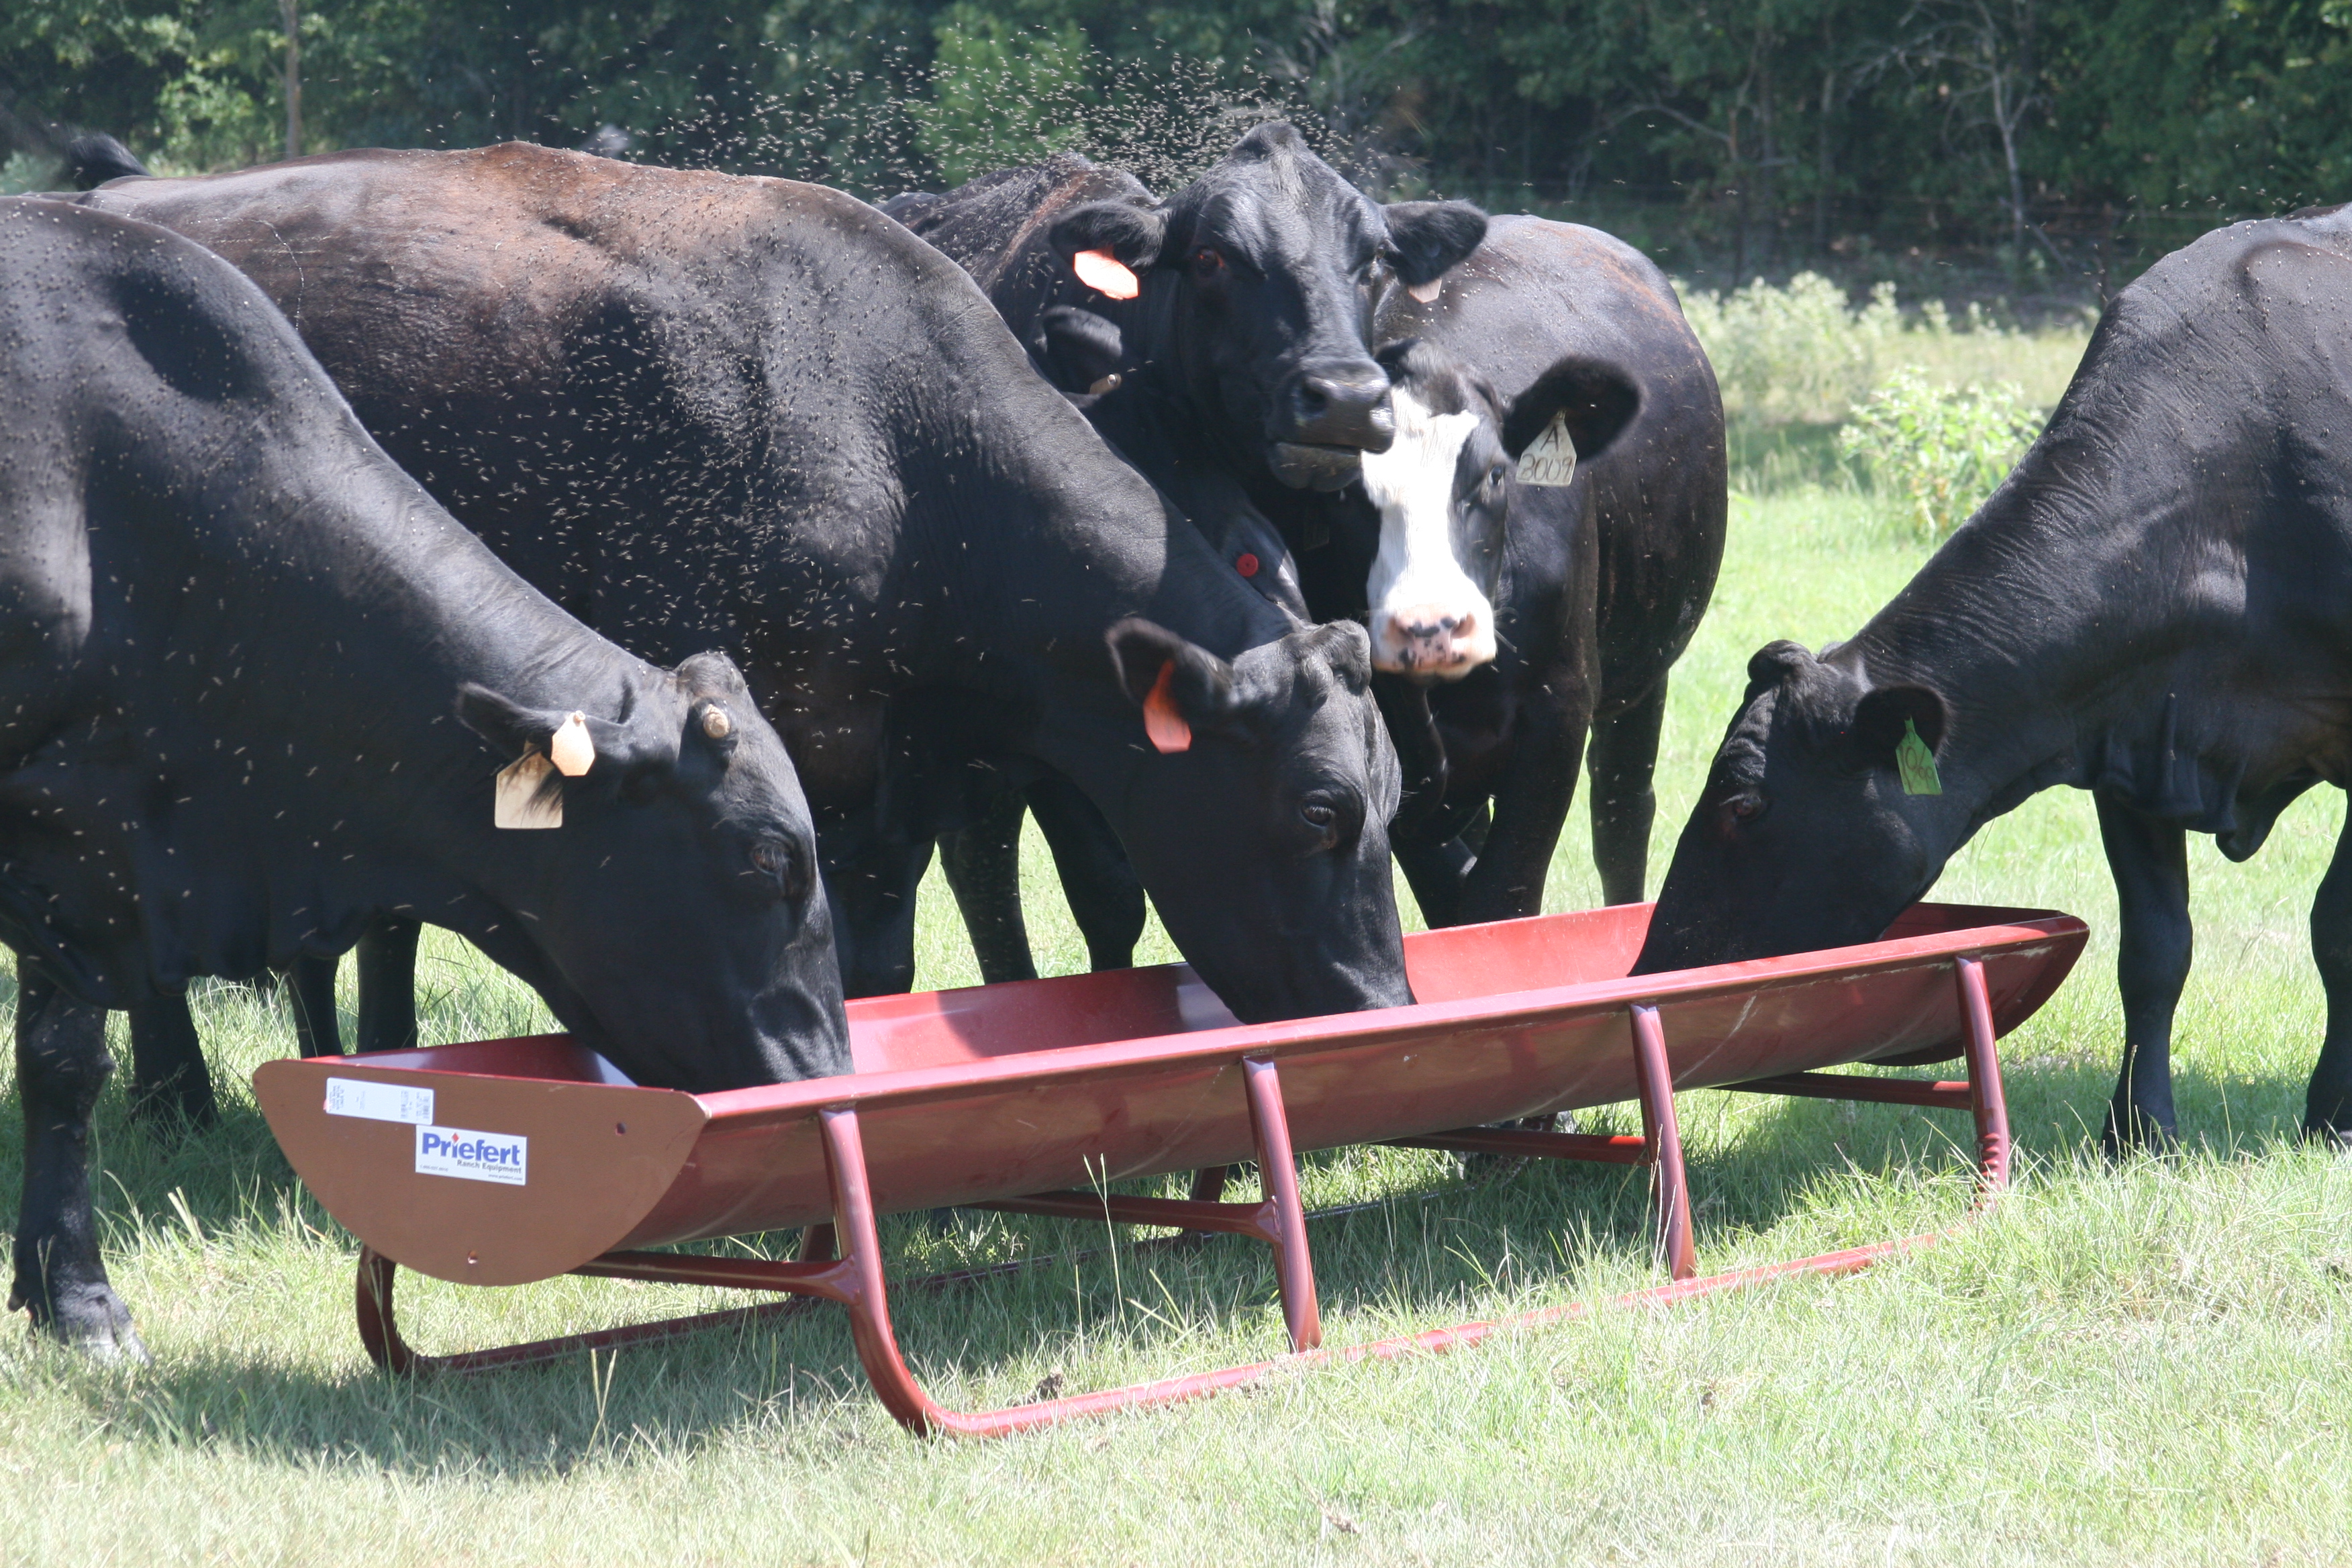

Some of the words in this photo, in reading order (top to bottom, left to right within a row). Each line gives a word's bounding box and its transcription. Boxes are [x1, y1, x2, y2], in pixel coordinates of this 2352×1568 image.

[1540, 424, 1559, 452] A
[422, 1132, 520, 1166] Priefert
[456, 1159, 480, 1169] Ranch
[482, 1163, 522, 1174] Equipment
